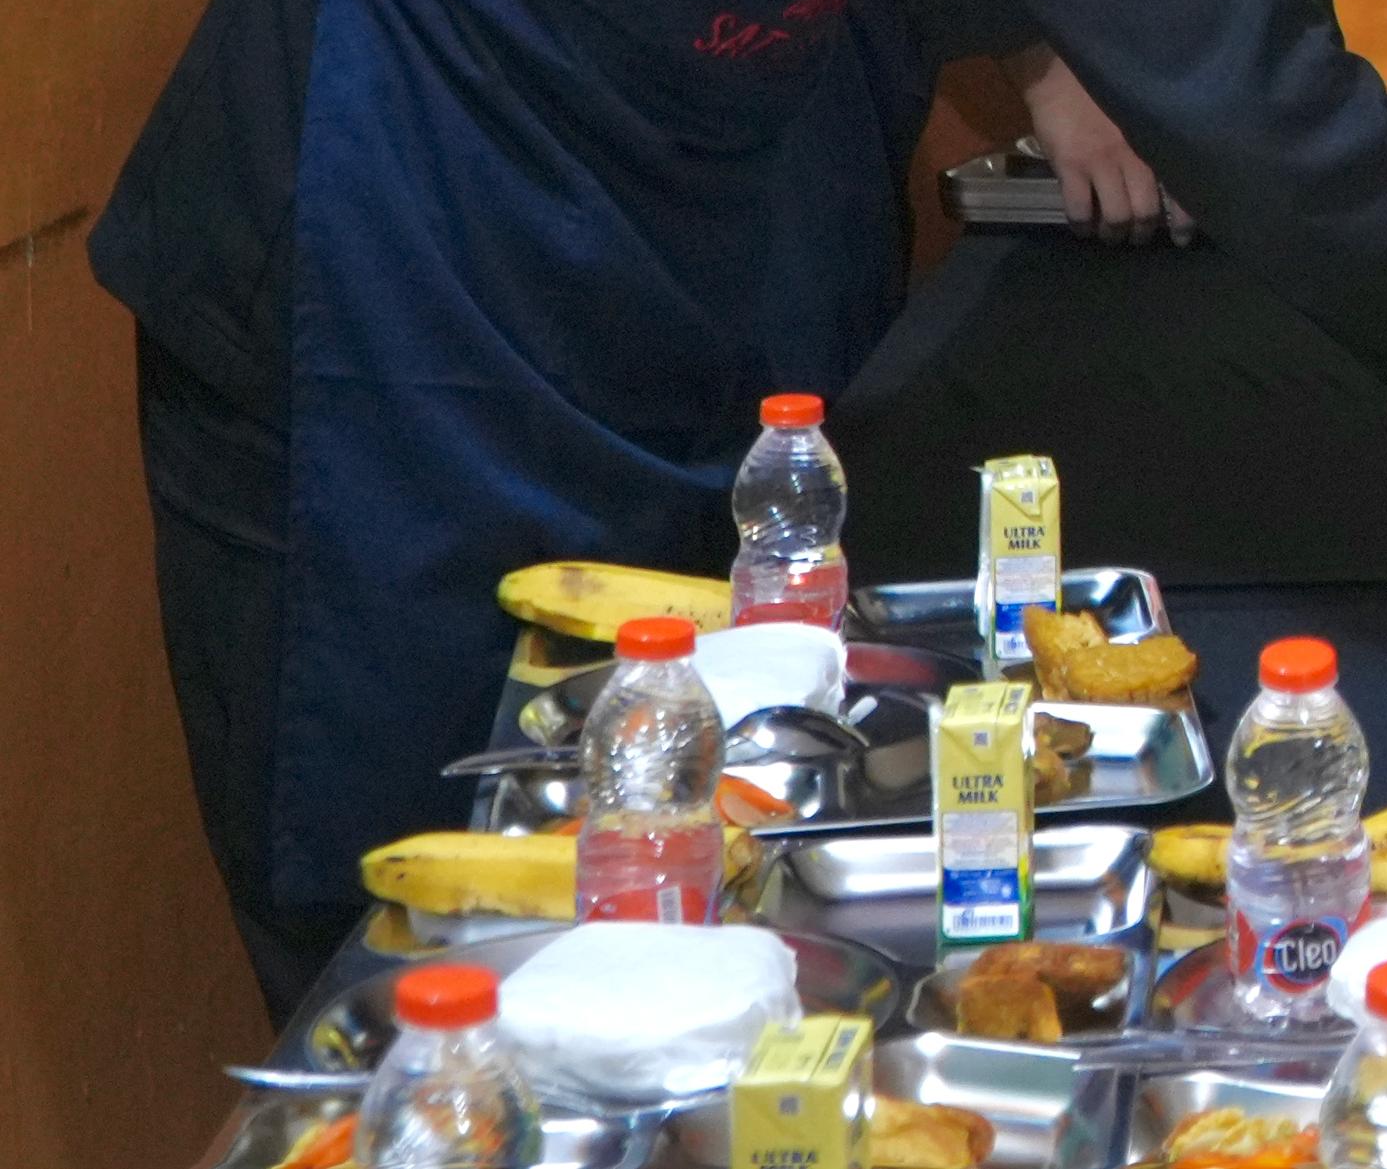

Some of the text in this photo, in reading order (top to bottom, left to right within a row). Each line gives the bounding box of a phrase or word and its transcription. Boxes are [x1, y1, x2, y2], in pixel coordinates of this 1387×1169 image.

[1003, 527, 1045, 539] ULTRA
[1008, 538, 1041, 551] MILK
[952, 774, 1004, 790] ULTRA
[957, 789, 999, 805] MILK
[1280, 933, 1338, 973] Cleo
